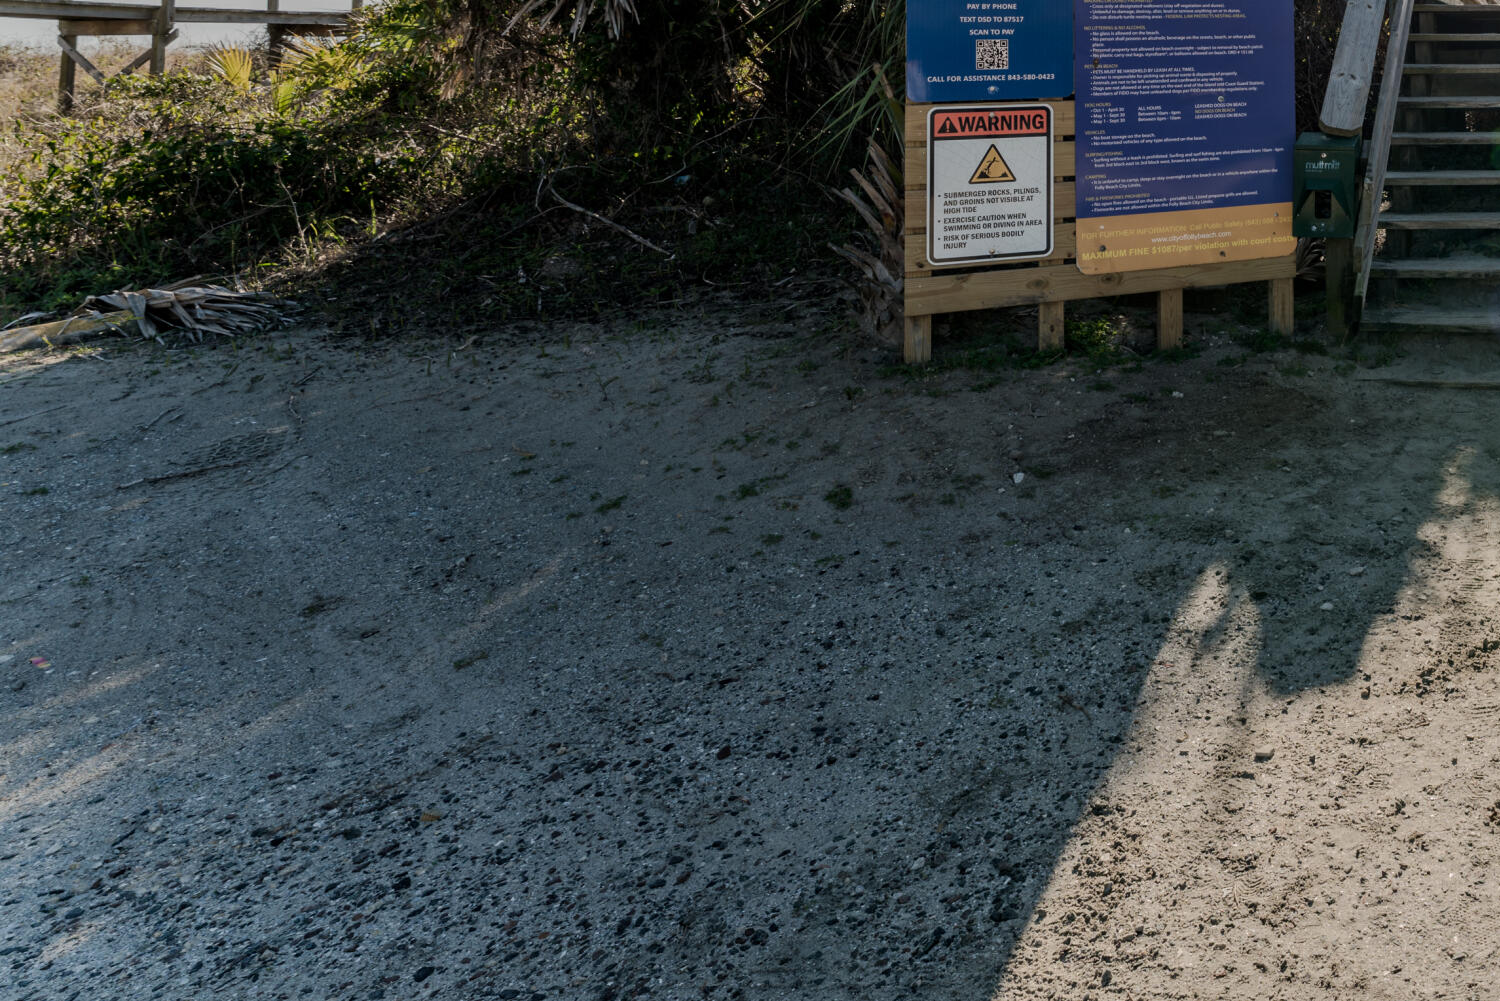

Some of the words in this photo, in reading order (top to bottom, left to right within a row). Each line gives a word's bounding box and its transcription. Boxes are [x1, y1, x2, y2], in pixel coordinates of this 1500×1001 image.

[927, 75, 945, 83] CALL
[963, 74, 1006, 82] ASSISTANCE
[1008, 73, 1055, 81] 843-580-0423
[957, 114, 1044, 132] WARNING
[943, 191, 986, 199] SUBMERGED
[987, 189, 1012, 197] ROCKS,
[943, 216, 976, 224] EXERCISE
[943, 224, 981, 232] SWIMMING
[971, 232, 1000, 240] SERIOUS
[1001, 230, 1025, 238] BODILY
[1081, 249, 1127, 260] MAXIMUM
[1128, 247, 1149, 256] FINE
[1194, 241, 1229, 251] violation
[1231, 239, 1248, 247] with
[1250, 237, 1271, 245] court
